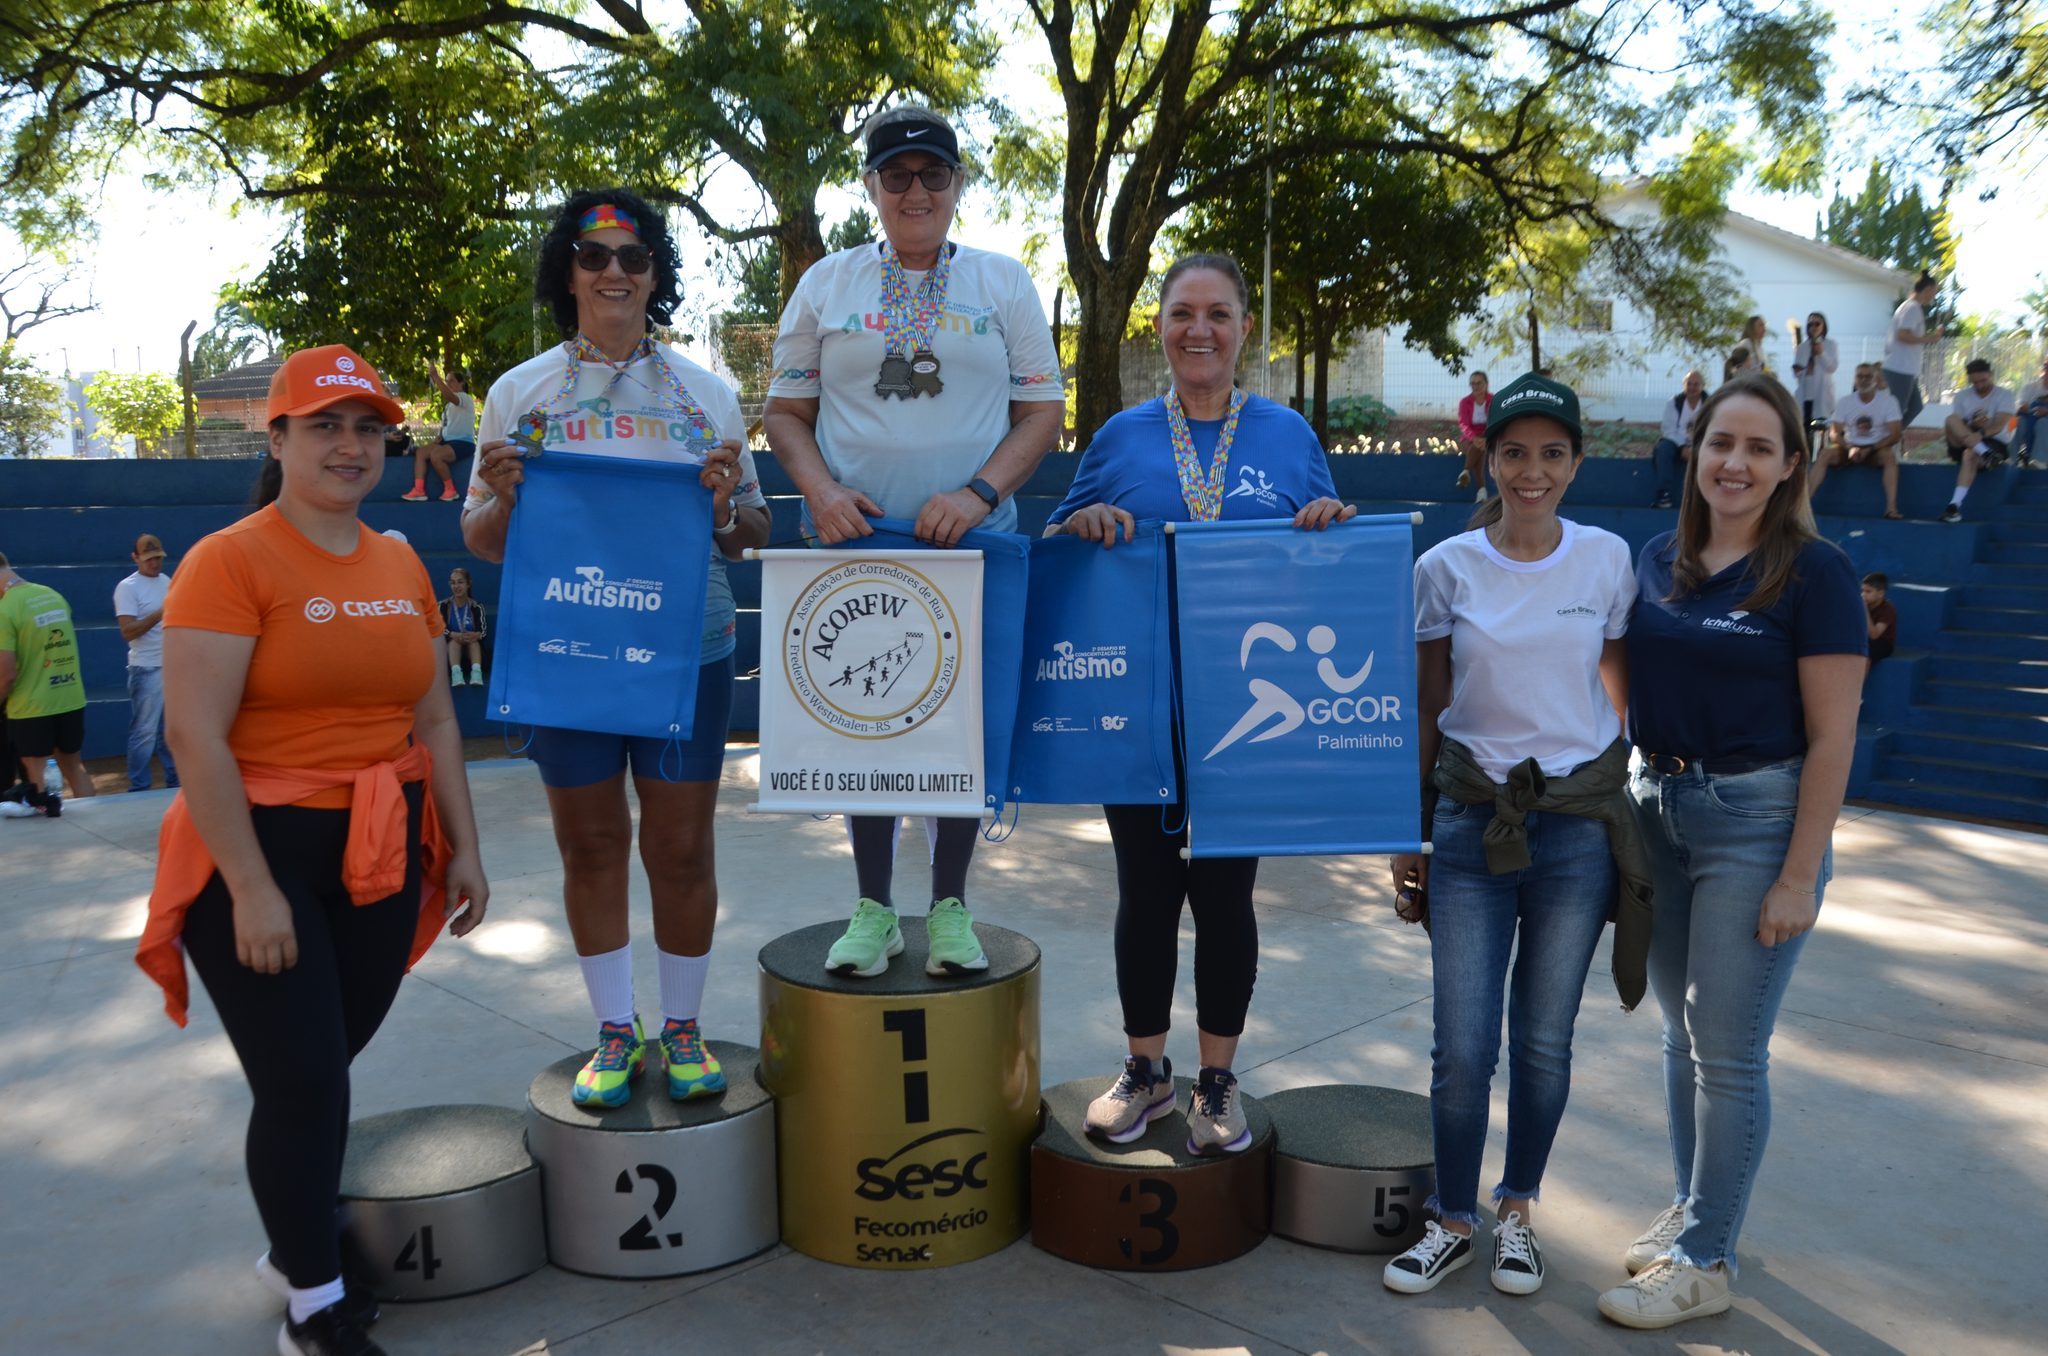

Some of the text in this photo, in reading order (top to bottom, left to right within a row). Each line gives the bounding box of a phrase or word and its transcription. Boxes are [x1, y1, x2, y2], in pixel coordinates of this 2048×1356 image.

[315, 374, 377, 394] CRESOL
[1501, 389, 1564, 408] Casa Branca
[545, 414, 688, 447] Autismo
[1255, 487, 1278, 502] GCOR
[342, 599, 420, 617] CRESOL
[544, 577, 662, 611] Autismo
[797, 564, 945, 620] Associação de Corredores de Rua
[812, 593, 908, 662] ACORFW
[789, 645, 811, 697] Frederico
[917, 655, 956, 715] Desde 2024
[1035, 657, 1127, 681] Autismo
[1307, 695, 1401, 725] GCOR
[1318, 733, 1403, 750] Palmitinho
[771, 769, 973, 793] VOCÊ É O SEU ÚNICO LIMITE!
[883, 1008, 930, 1124] 1
[615, 1163, 683, 1250] 2
[855, 1208, 988, 1238] Fecomércio
[1118, 1178, 1180, 1265] 3
[1372, 1185, 1410, 1238] 5
[393, 1225, 442, 1280] 4
[856, 1243, 931, 1263] Senac
